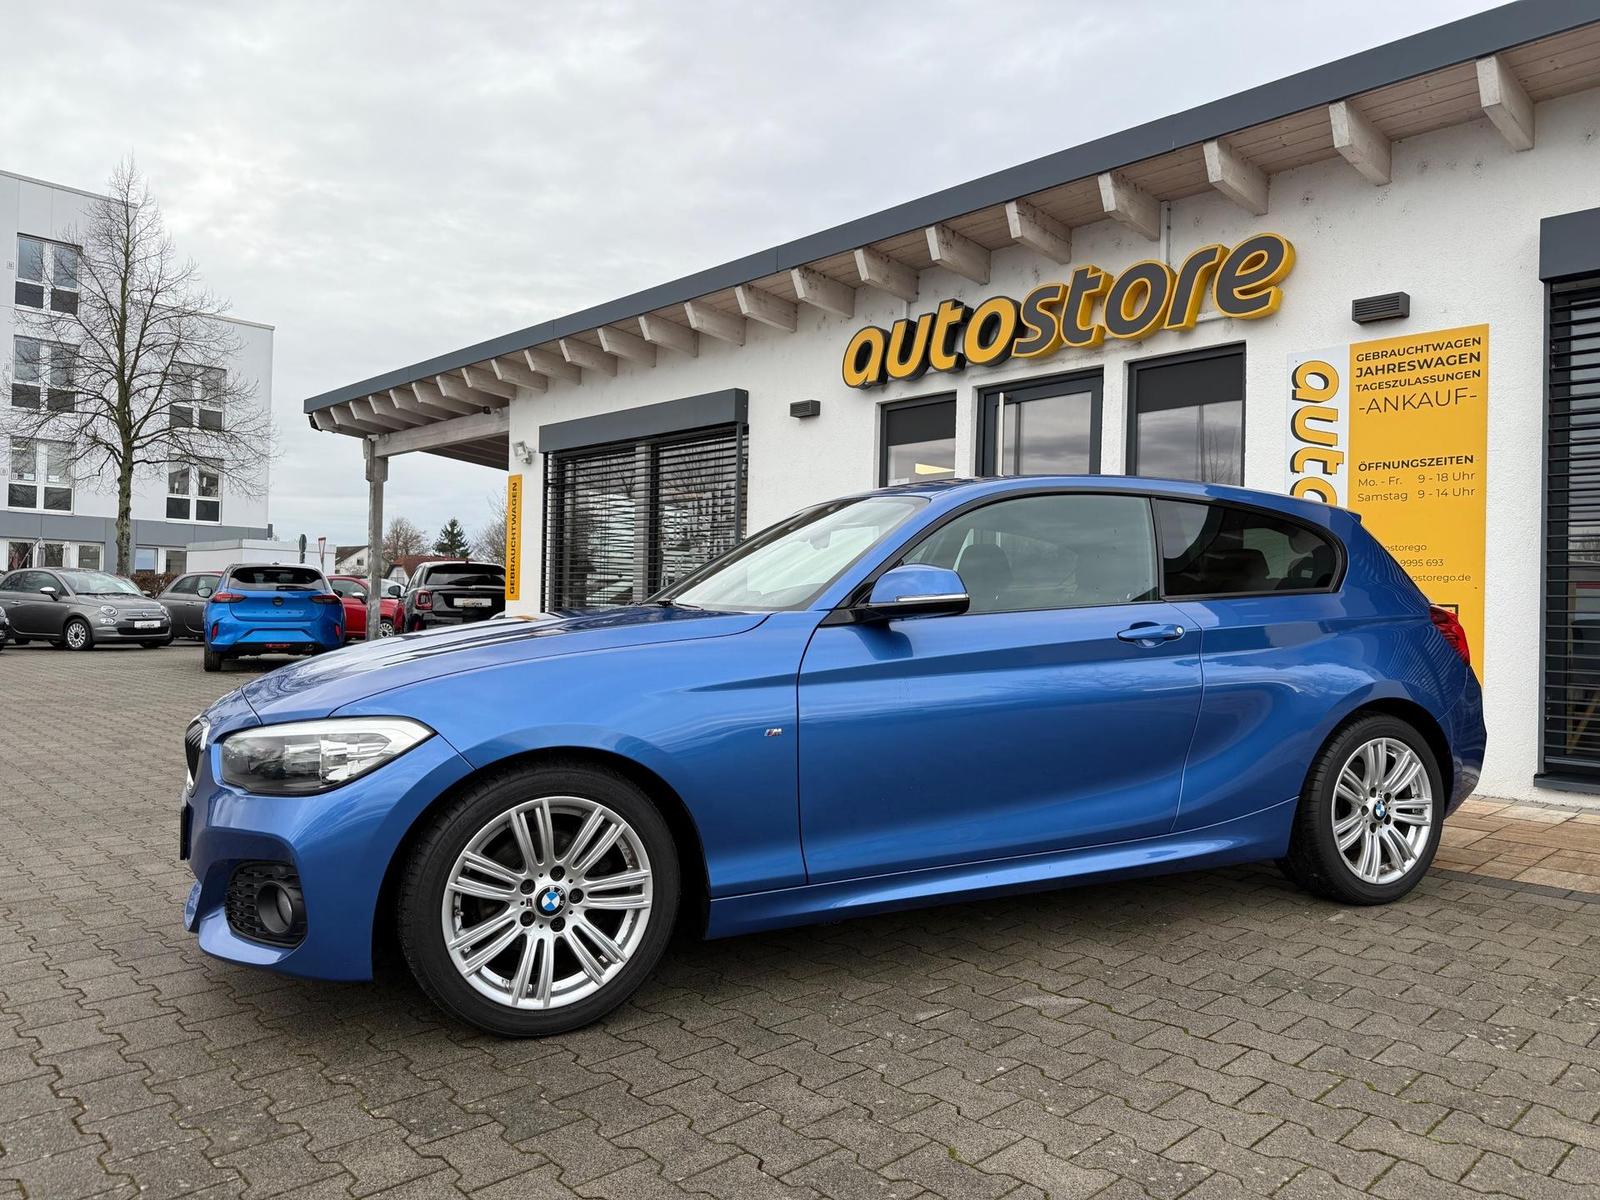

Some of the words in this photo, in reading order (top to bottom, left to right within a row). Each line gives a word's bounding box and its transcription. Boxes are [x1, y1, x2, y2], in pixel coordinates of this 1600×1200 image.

[842, 232, 1296, 390] autostore
[1356, 337, 1482, 362] GEBRAUCHTWAGEN
[1356, 351, 1481, 378] JAHRESWAGEN
[1356, 369, 1481, 392] TAGESZULASSUNGEN
[1359, 387, 1478, 414] -ANKAUF-
[1290, 360, 1344, 507] auto
[1358, 455, 1475, 472] ÖFFNUNGSZEITEN
[1358, 478, 1378, 487] Mo.
[1388, 476, 1403, 486] Fr.
[1418, 474, 1425, 484] 9
[1437, 473, 1449, 482] 18
[1452, 471, 1475, 481] Uhr
[1357, 492, 1408, 502] Samstag
[1418, 489, 1425, 499] 9
[1436, 488, 1448, 498] 14
[1452, 487, 1475, 497] Uhr
[509, 482, 518, 594] GEBRAUCHTWAGEN
[1385, 544, 1427, 553] ostorego
[1425, 558, 1444, 567] 693
[1411, 573, 1472, 583] ostorego.de
